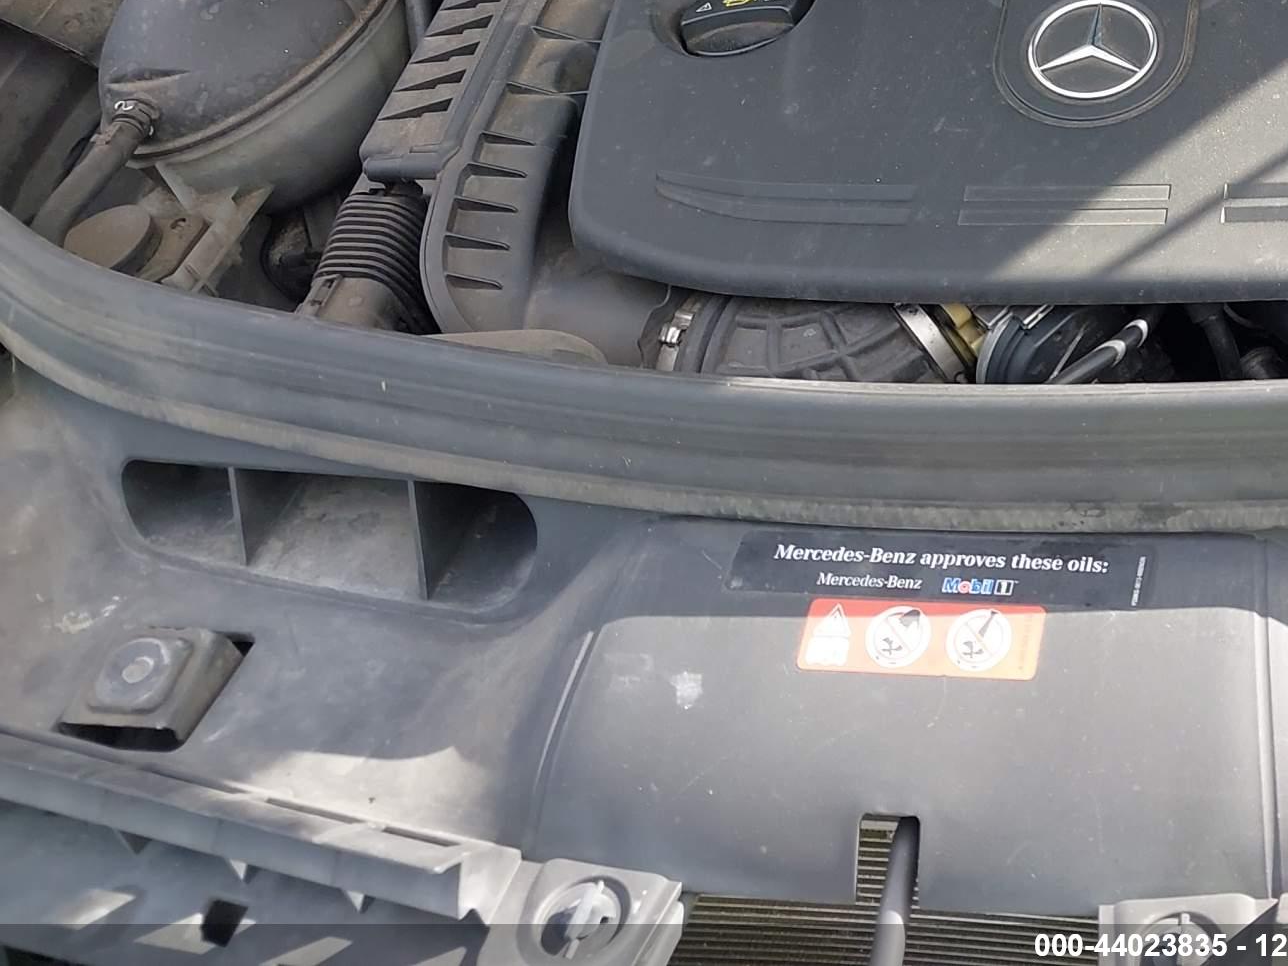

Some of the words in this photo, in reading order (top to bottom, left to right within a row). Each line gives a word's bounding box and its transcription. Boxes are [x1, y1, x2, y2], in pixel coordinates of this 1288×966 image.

[774, 544, 916, 565] Mercedes-Benz
[920, 552, 1006, 569] approves
[1011, 554, 1063, 571] these
[1067, 557, 1109, 573] oils:
[816, 572, 923, 590] Mercedes-Benz
[942, 577, 994, 595] Mobil
